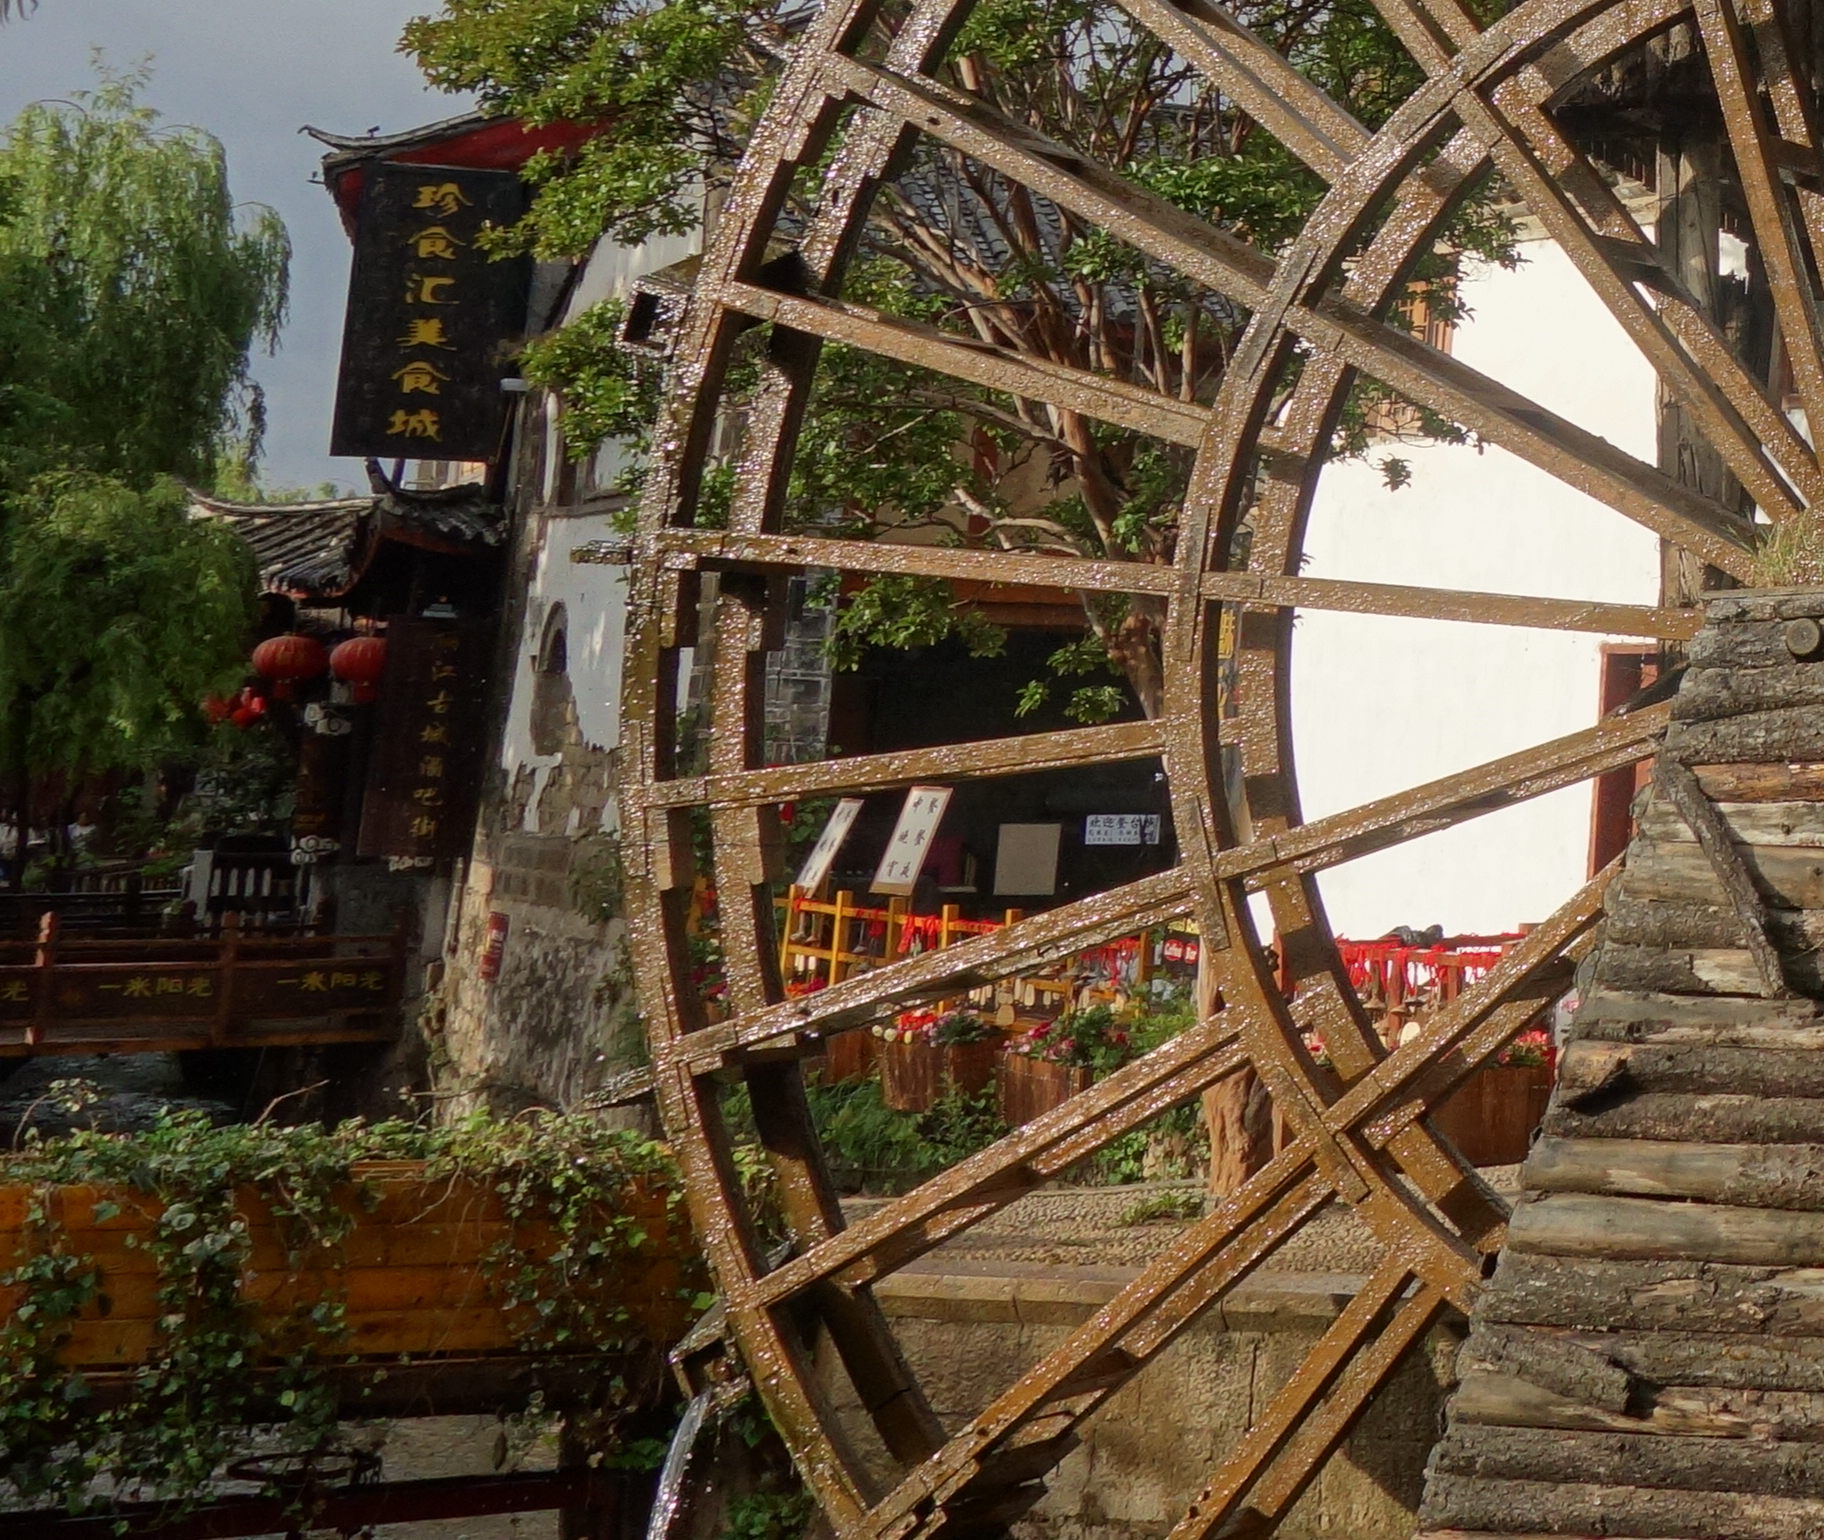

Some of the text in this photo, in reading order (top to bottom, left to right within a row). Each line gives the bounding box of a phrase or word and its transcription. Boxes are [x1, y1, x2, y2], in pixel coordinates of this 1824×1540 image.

[385, 182, 474, 443] 珍食汇美食城
[98, 975, 213, 997] 一米阳光
[276, 971, 384, 992] 一米阳光
